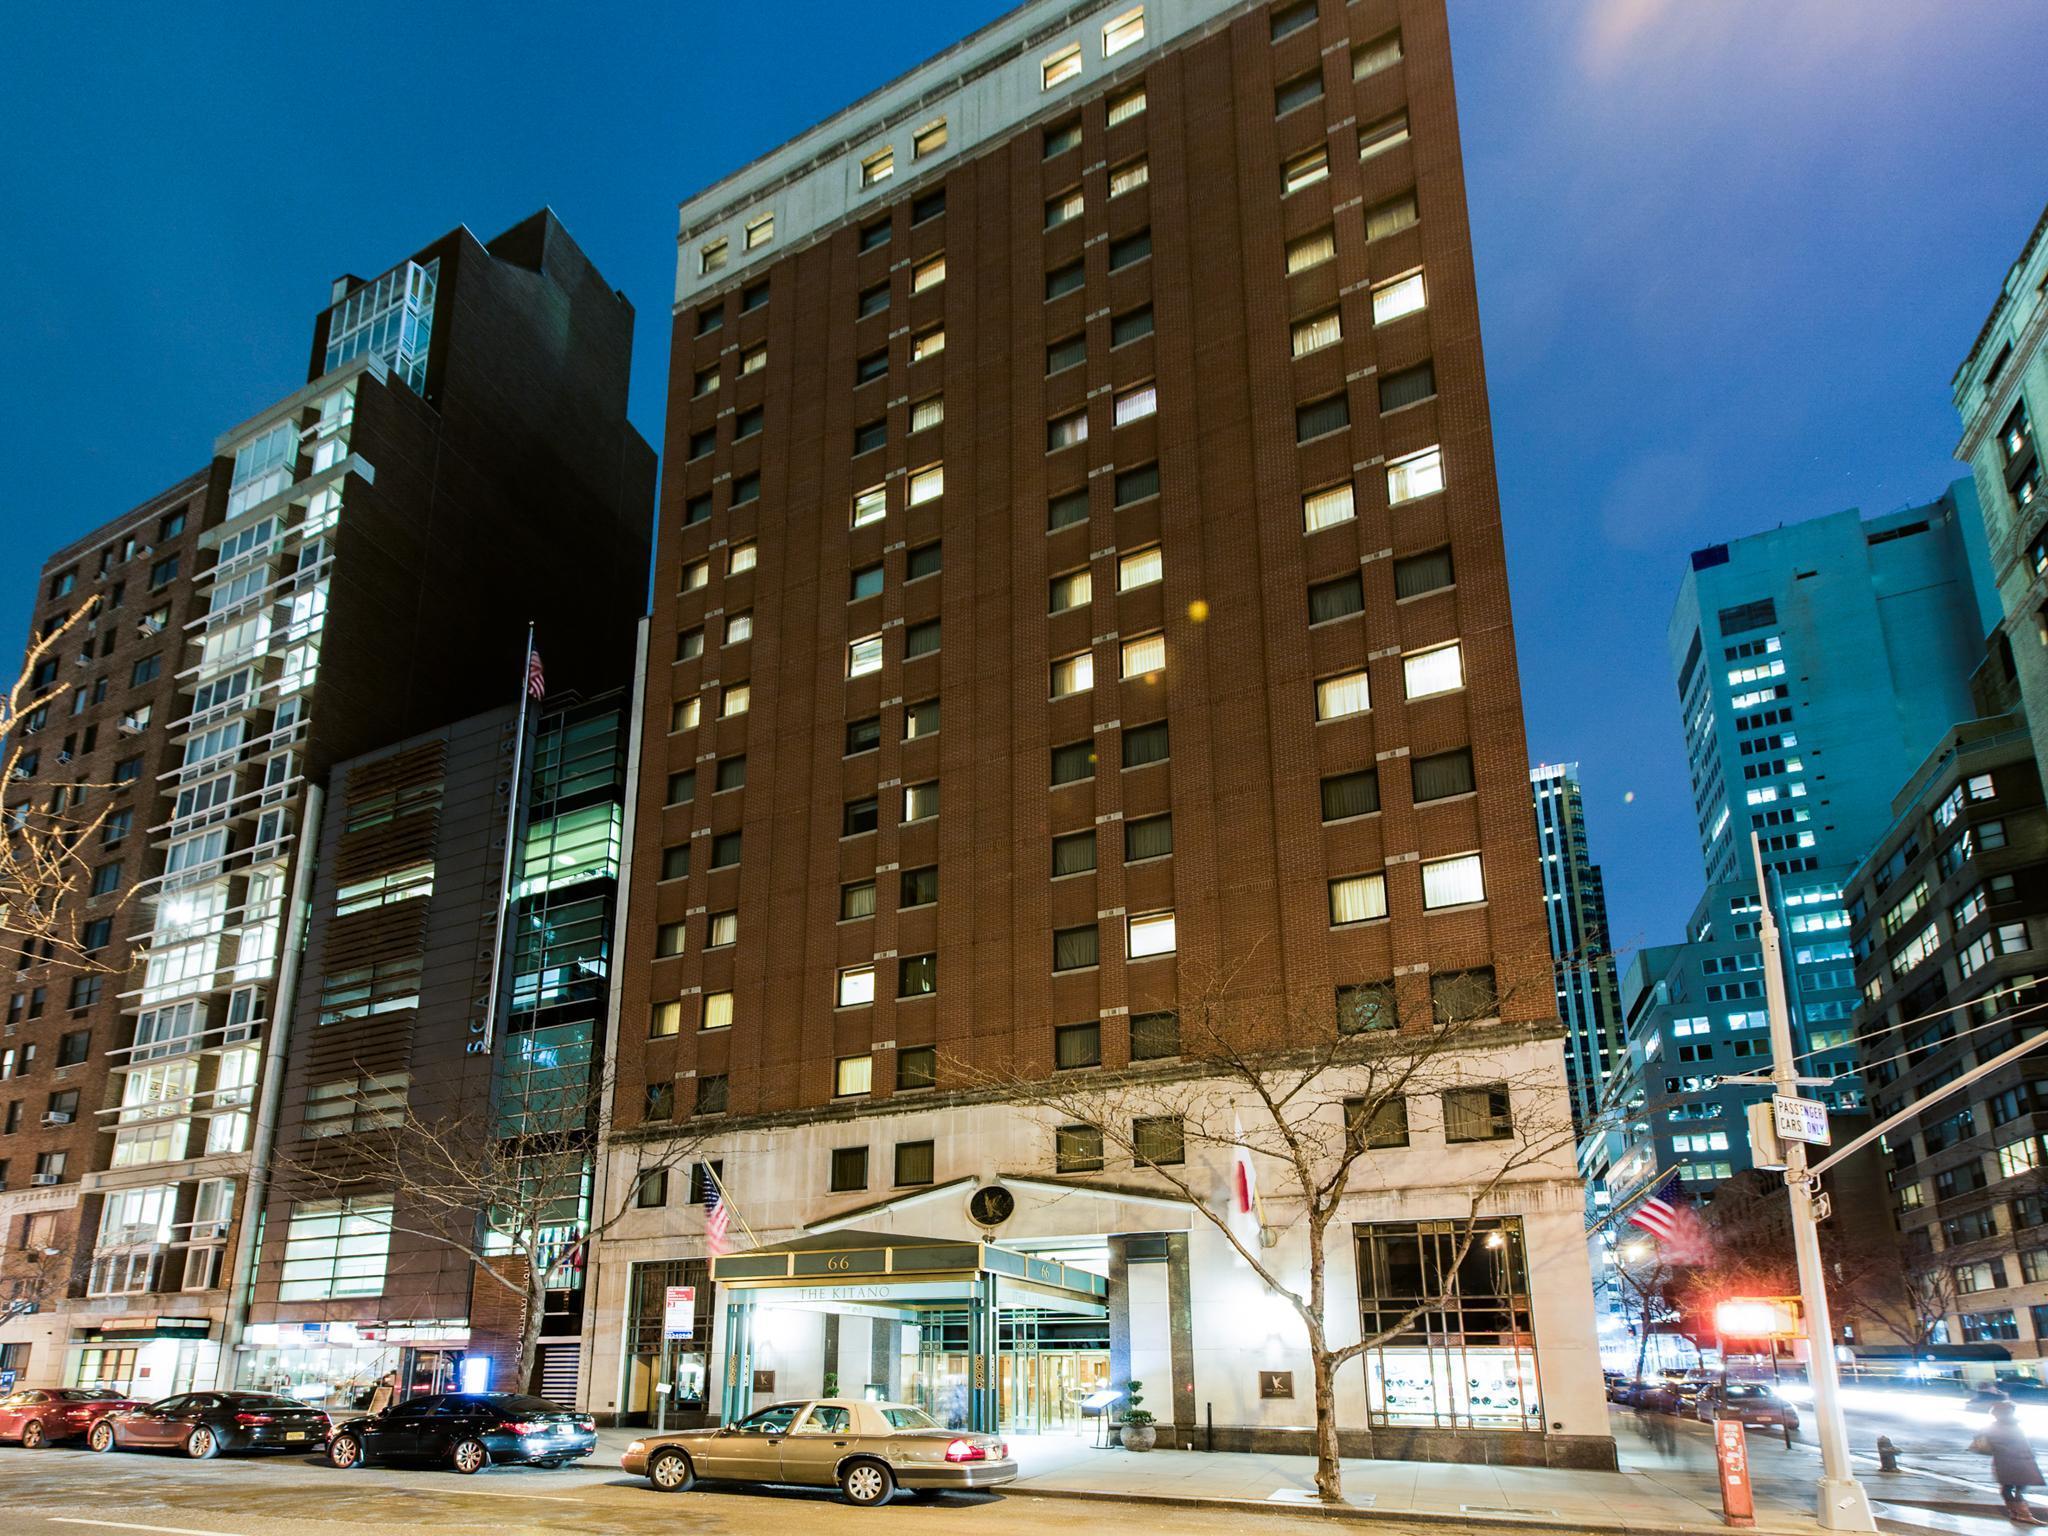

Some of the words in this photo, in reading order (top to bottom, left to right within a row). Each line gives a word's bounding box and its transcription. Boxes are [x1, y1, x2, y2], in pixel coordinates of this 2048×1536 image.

[1778, 1101, 1823, 1119] PASSENGER
[1781, 1118, 1802, 1132] CARS
[1807, 1122, 1824, 1136] ONLY
[828, 1255, 849, 1270] 66
[1041, 1264, 1050, 1280] 66
[800, 1288, 825, 1300] THE
[832, 1286, 890, 1299] KITANO
